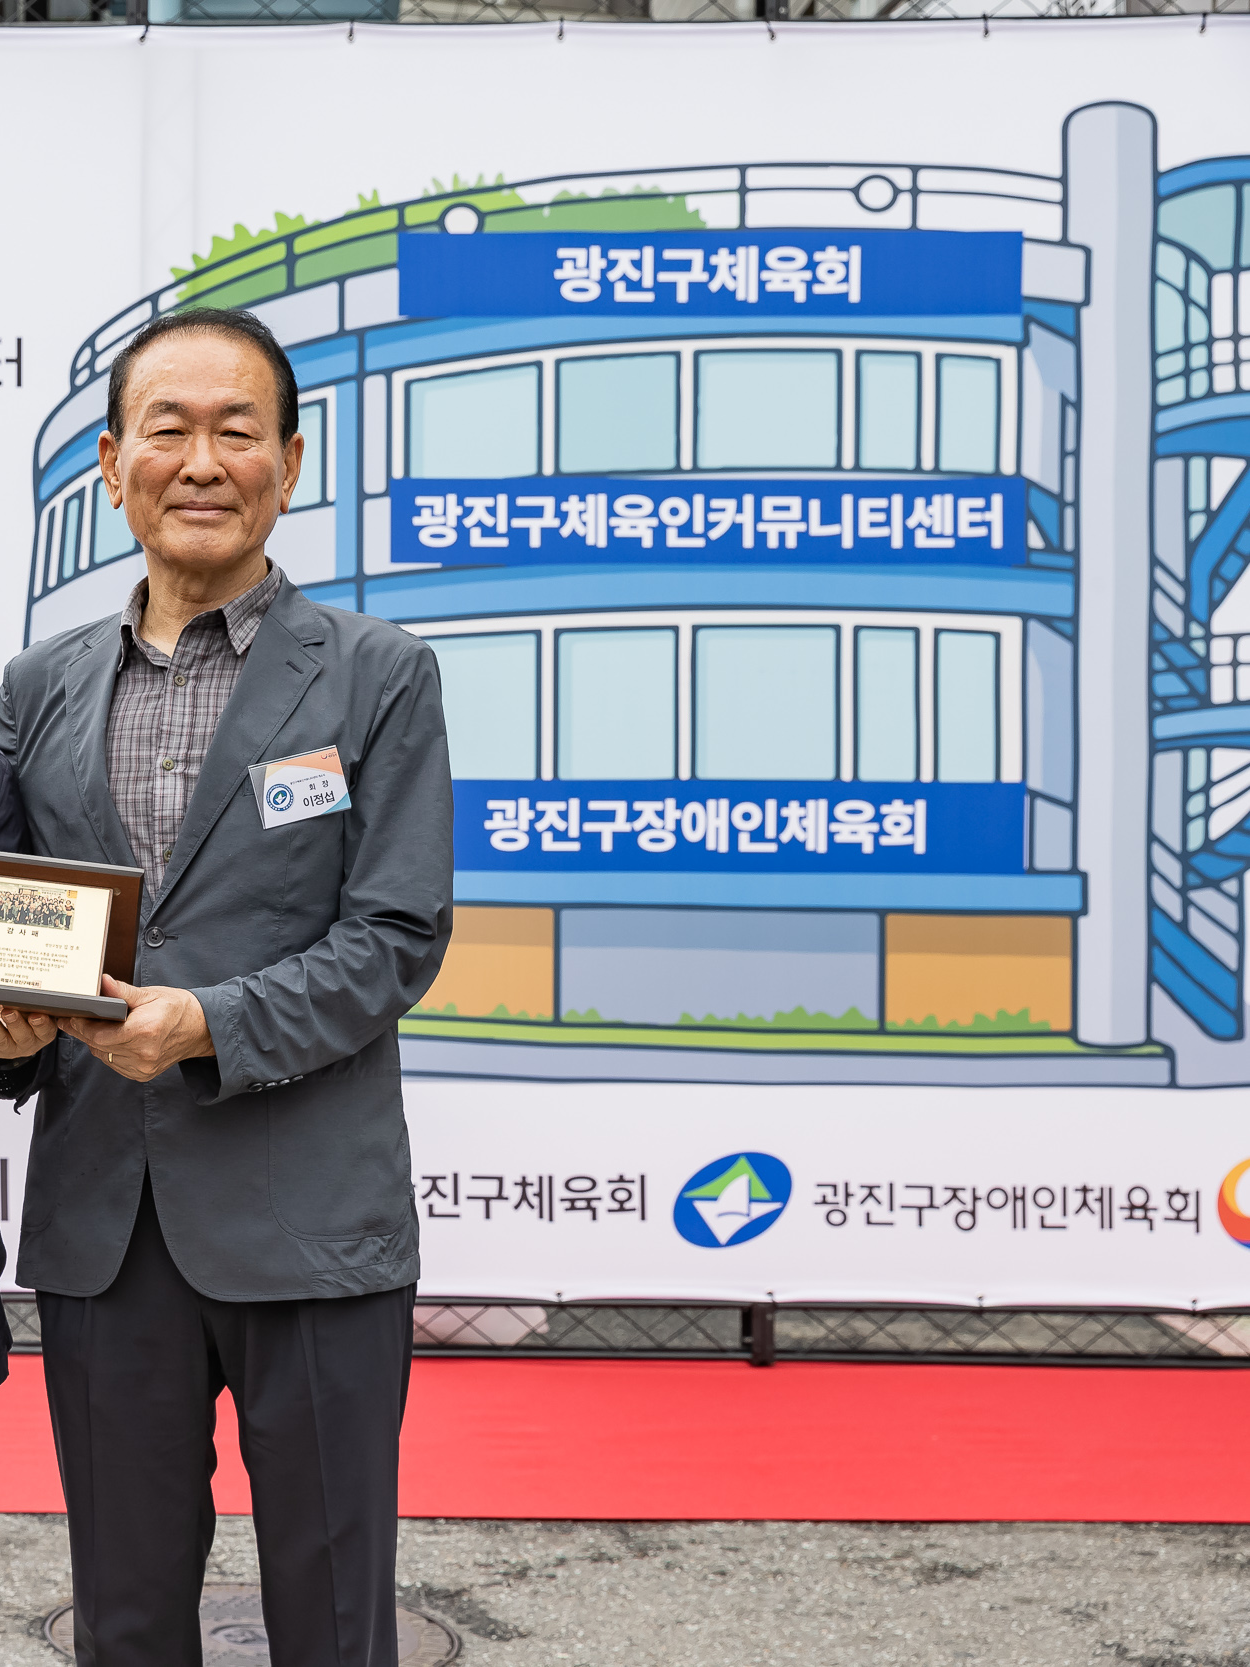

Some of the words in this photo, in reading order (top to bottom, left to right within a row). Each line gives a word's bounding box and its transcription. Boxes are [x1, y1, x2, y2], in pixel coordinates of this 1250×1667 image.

[553, 245, 862, 303] 광진구체육회
[411, 493, 1004, 549] 광진구체육인커뮤니티센터
[303, 790, 336, 807] 이정섭
[483, 796, 927, 855] 광진구장애인체육회
[412, 1171, 648, 1224] 진구체육회
[813, 1180, 1202, 1235] 광진구장애인체육회
